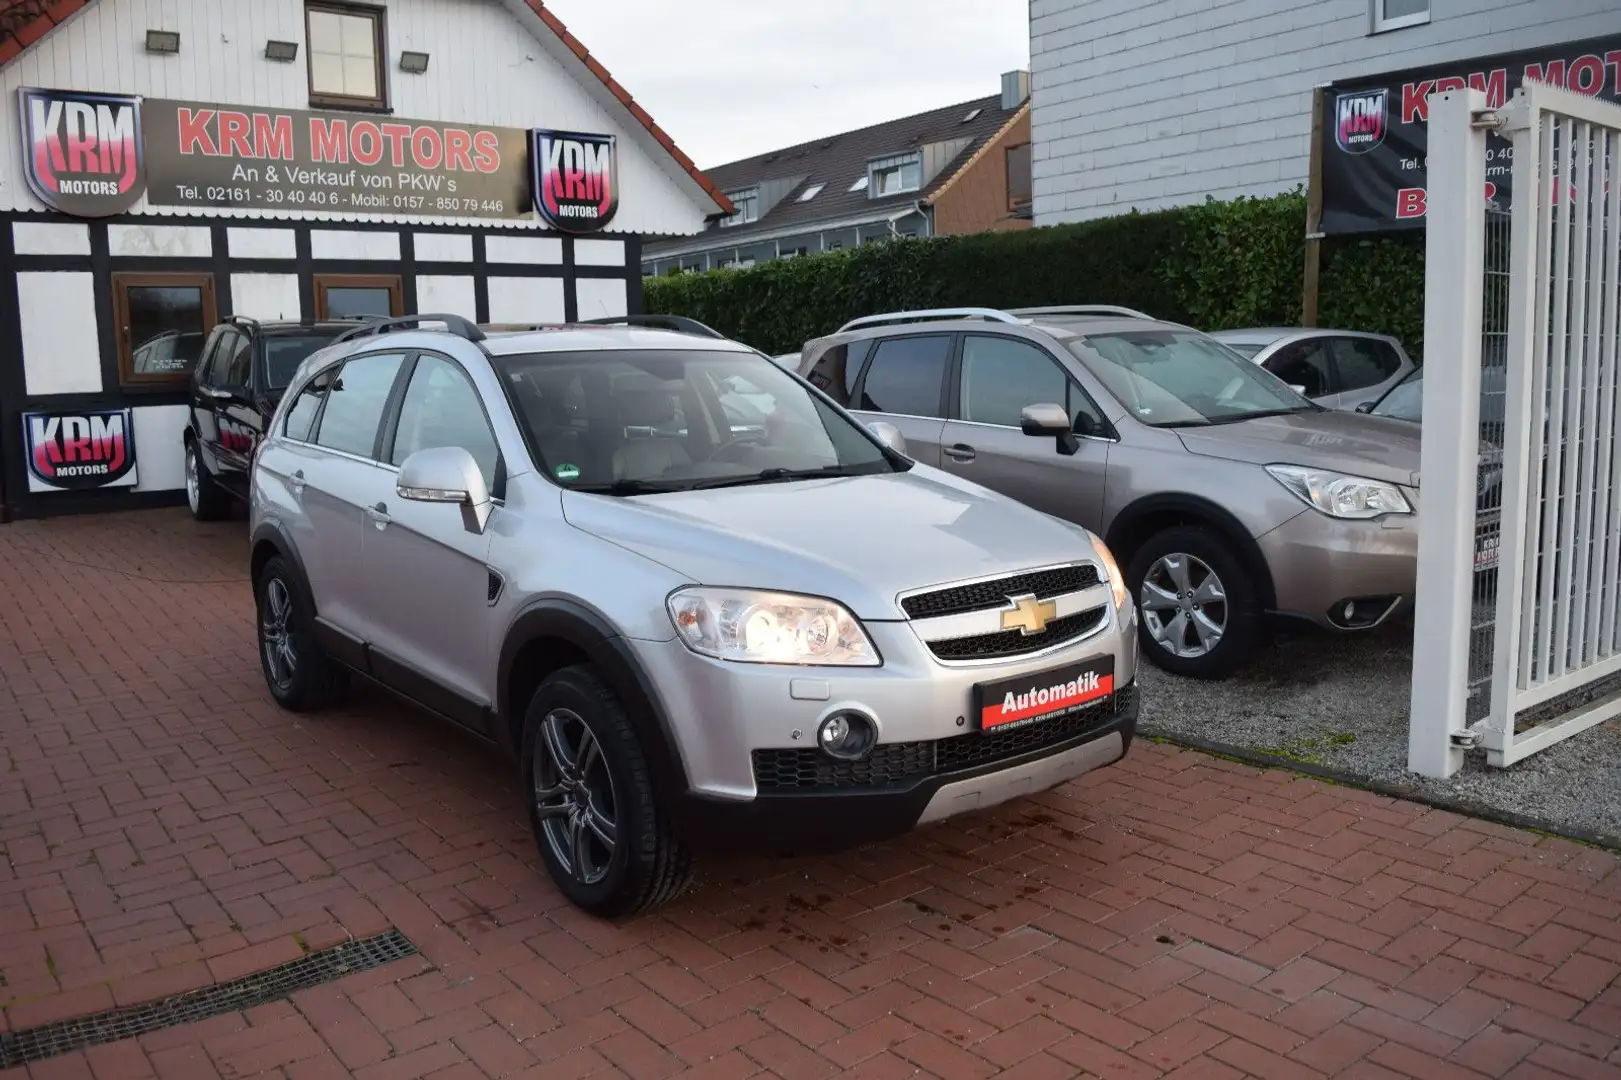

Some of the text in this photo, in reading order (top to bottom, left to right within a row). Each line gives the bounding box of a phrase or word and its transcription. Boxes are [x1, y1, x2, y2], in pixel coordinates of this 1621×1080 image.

[1341, 96, 1382, 133] KRM
[31, 99, 137, 174] KRM
[177, 107, 501, 174] KRM MOTORS
[1348, 134, 1373, 144] MOTORS
[232, 164, 259, 182] An
[265, 165, 279, 183] &
[284, 166, 356, 187] Verkauf
[360, 174, 392, 189] von
[541, 138, 609, 200] KRM
[1400, 157, 1420, 170] Tel.
[60, 180, 118, 196] MOTORS
[176, 185, 202, 200] Tel.
[207, 186, 250, 201] 02161
[266, 189, 283, 203] 30
[287, 190, 305, 203] 40
[309, 191, 326, 204] 40
[329, 192, 339, 204] 6
[351, 193, 390, 208] Mobil:
[393, 195, 424, 209] 0157
[436, 197, 460, 210] 850
[463, 199, 478, 211] 79
[481, 199, 503, 212] 446
[559, 204, 598, 218] MOTORS
[32, 416, 125, 463] KRM
[56, 464, 108, 477] MOTORS
[1001, 671, 1100, 714] Automatik
